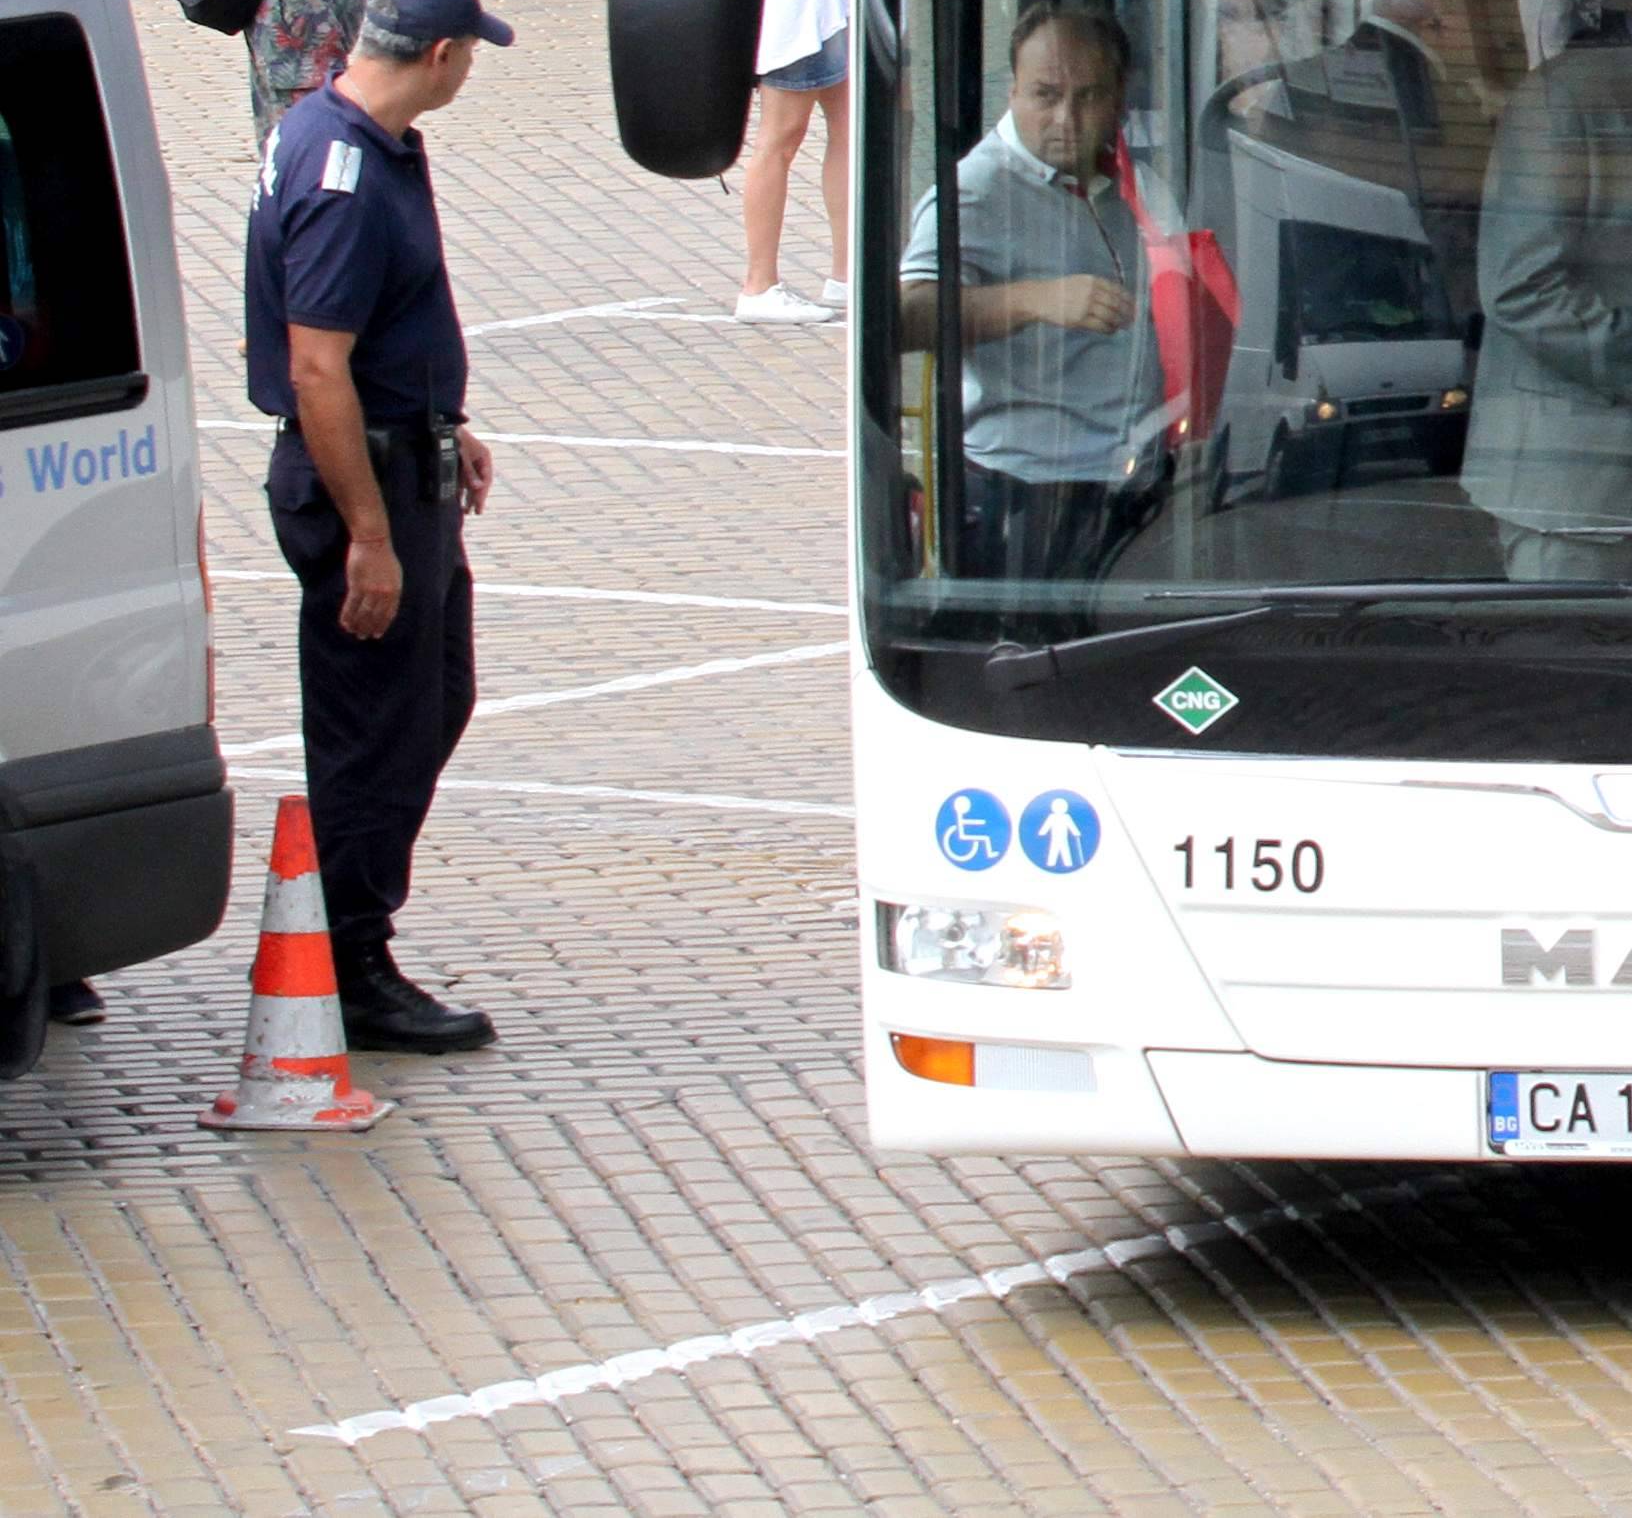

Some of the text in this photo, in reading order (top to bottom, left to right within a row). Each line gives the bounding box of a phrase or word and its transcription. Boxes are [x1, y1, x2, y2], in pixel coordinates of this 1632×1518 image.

[26, 424, 157, 493] World
[1171, 690, 1222, 710] CNG
[1174, 835, 1325, 893] 1150
[1494, 1116, 1517, 1132] BG
[1529, 1082, 1598, 1133] CA
